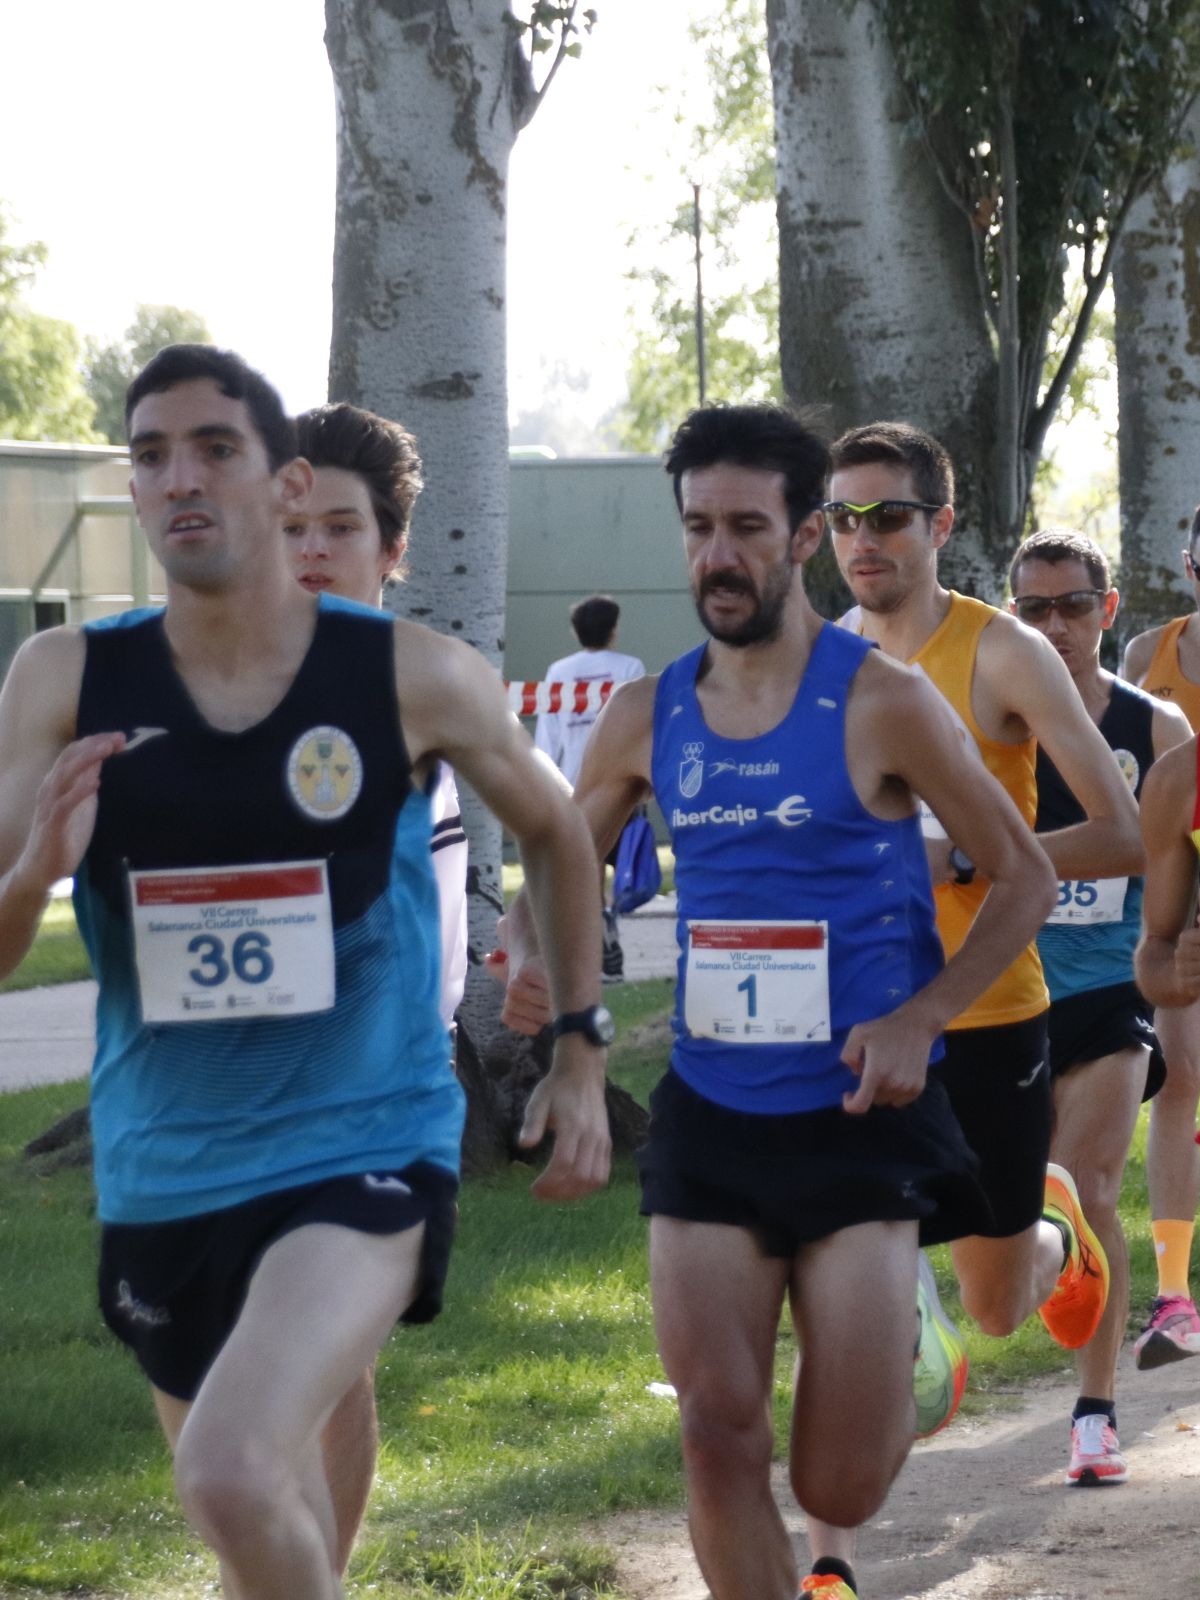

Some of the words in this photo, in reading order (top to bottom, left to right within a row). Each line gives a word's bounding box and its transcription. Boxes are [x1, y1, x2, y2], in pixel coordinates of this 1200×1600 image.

[739, 759, 779, 776] rasán
[217, 906, 258, 918] Carrera
[148, 919, 202, 932] Salamanca
[205, 917, 243, 930] Ciudad
[246, 912, 316, 927] Universitaria
[187, 931, 274, 987] 36
[742, 952, 772, 961] Carrera
[695, 962, 731, 970] Salamanca
[732, 962, 760, 970] Ciudad
[762, 962, 816, 970] Universitaria
[737, 973, 757, 1017] 1
